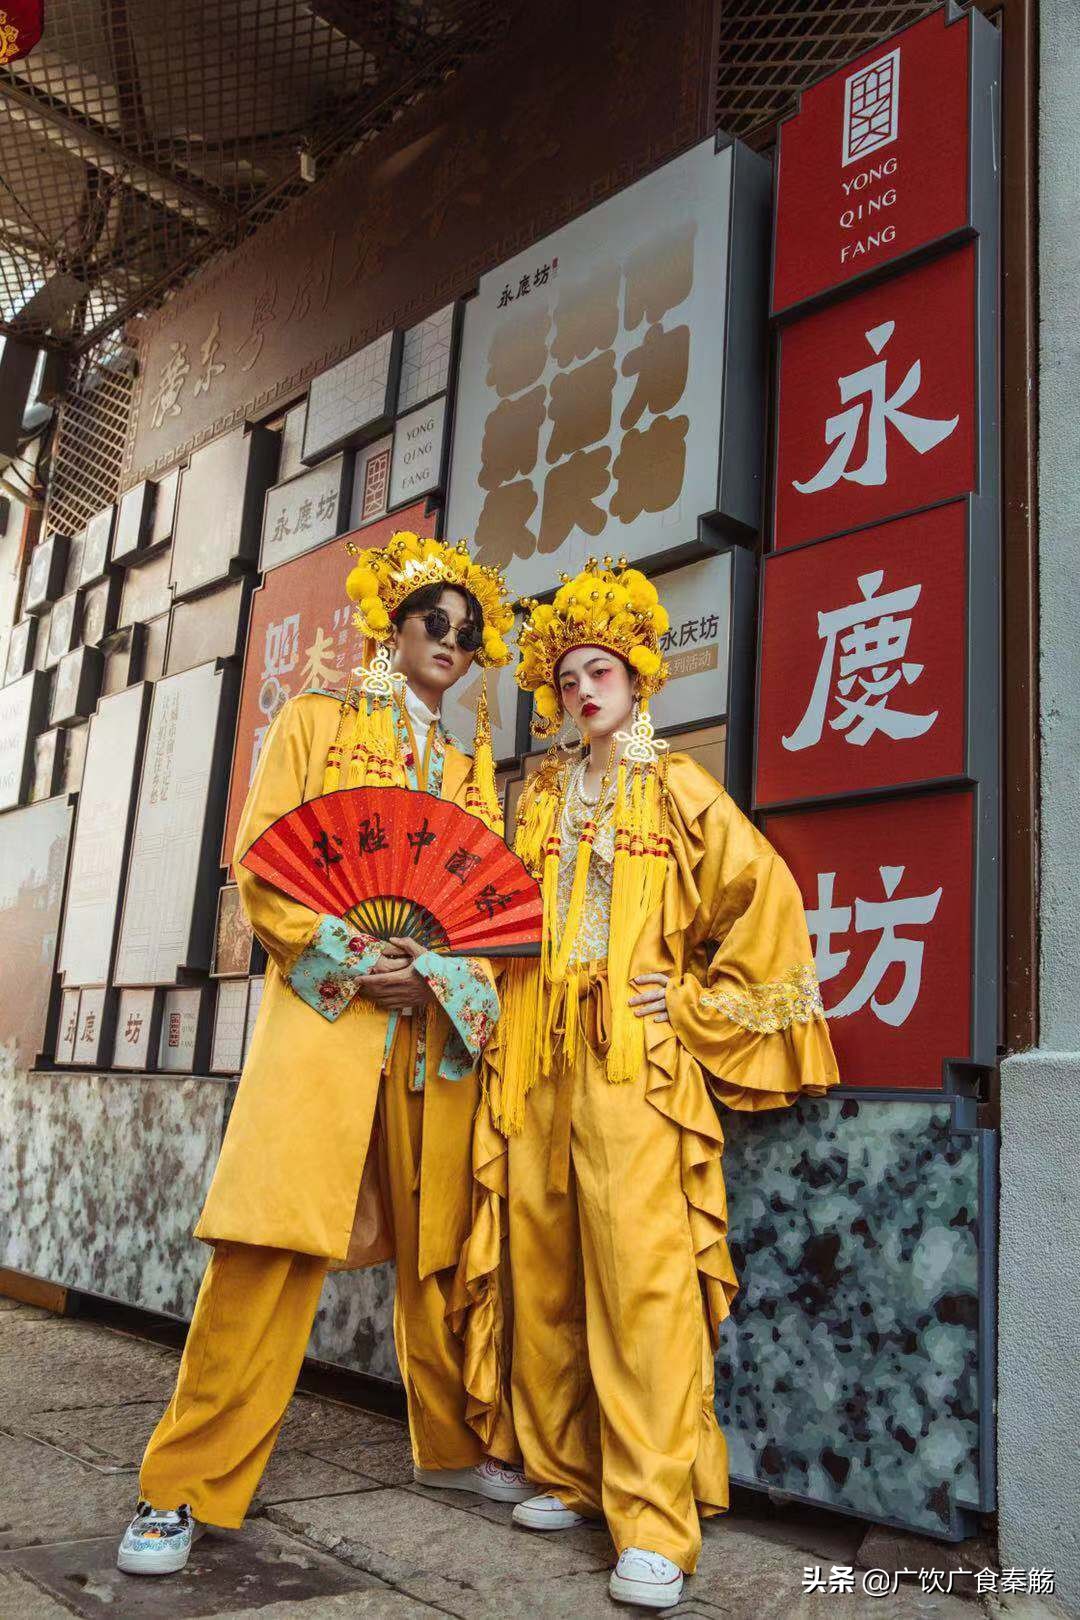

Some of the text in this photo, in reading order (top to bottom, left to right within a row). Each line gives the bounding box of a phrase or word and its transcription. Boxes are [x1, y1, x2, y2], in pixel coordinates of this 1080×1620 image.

[842, 157, 897, 195] YONG
[840, 189, 897, 229] QING
[840, 225, 896, 263] FANG
[406, 418, 435, 441] YONG
[403, 441, 433, 465] QING
[401, 467, 431, 489] FANG
[660, 613, 719, 652] 永庆坊
